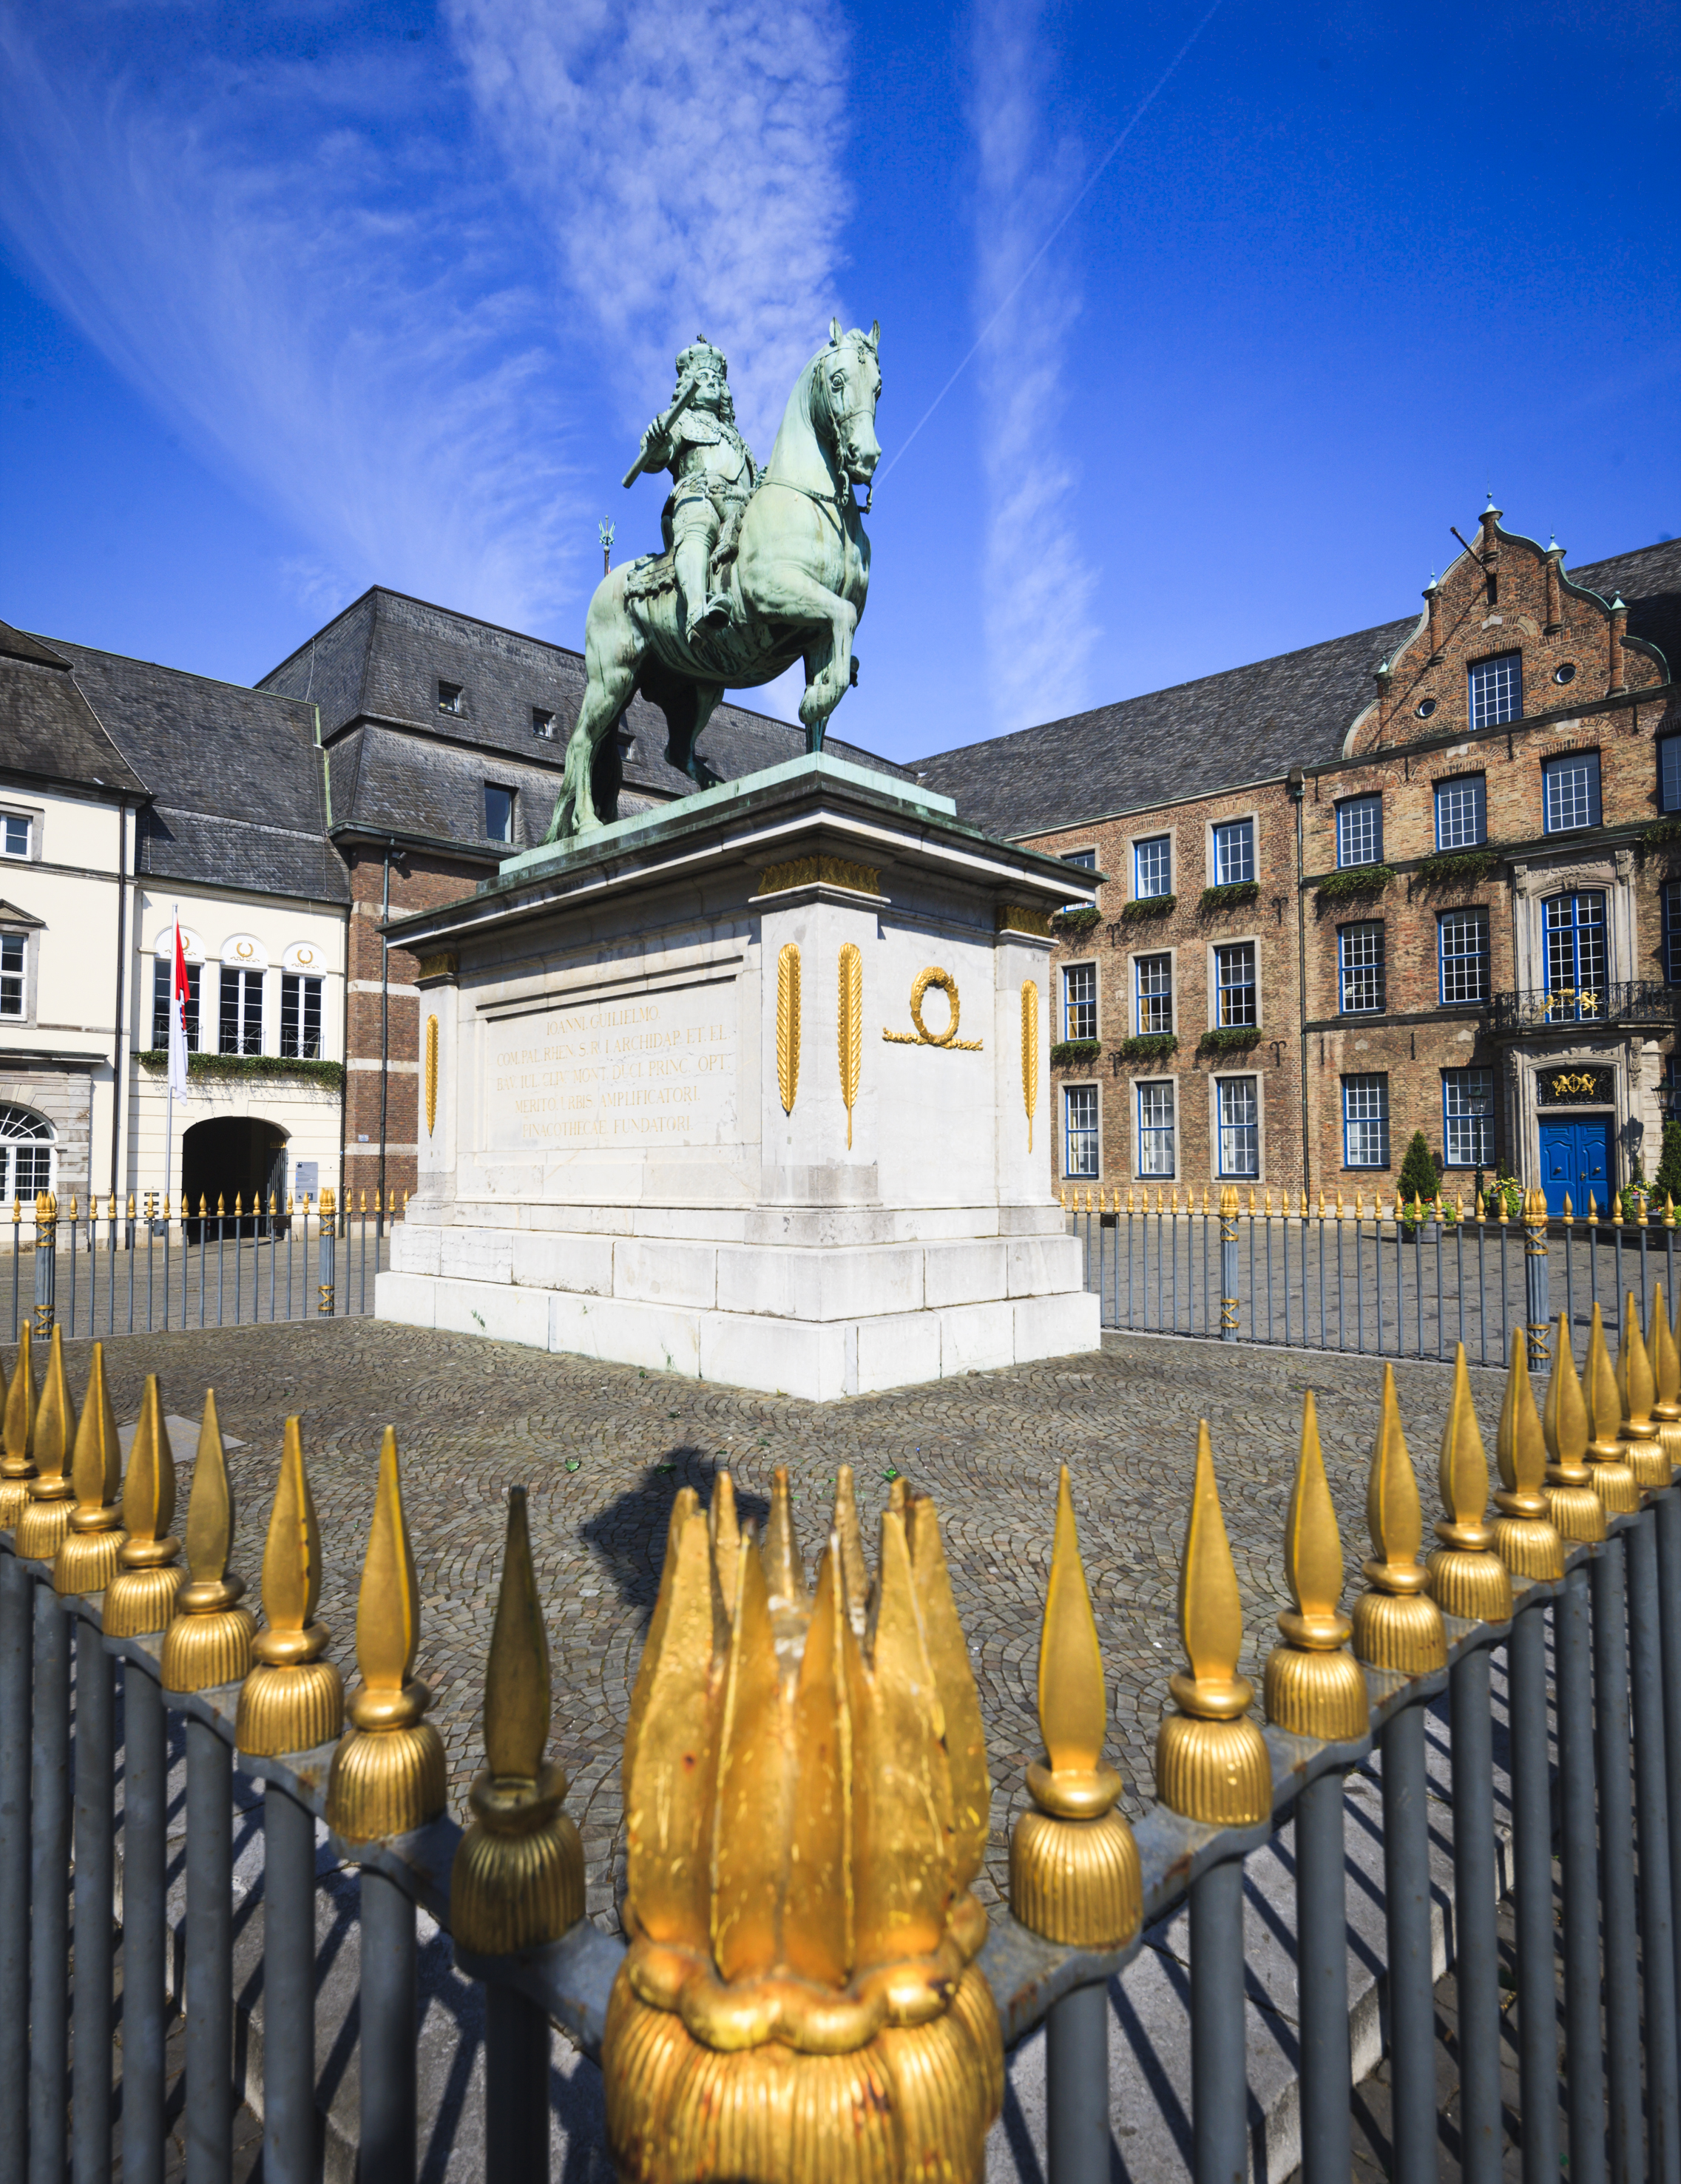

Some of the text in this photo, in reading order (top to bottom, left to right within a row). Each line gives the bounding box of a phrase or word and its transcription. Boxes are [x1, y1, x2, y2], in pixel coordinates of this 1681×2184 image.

[546, 1006, 661, 1036] IOANNI. GUILIELMO.
[497, 1052, 519, 1066] COM.
[521, 1049, 543, 1064] PAL.
[544, 1044, 575, 1061] RHEN.
[578, 1042, 589, 1057] S.
[686, 1027, 706, 1044] ET.
[710, 1024, 731, 1041] EL.
[521, 1074, 540, 1089] IUL.
[649, 1058, 691, 1077] PRINC.
[698, 1054, 731, 1072] OPT.
[515, 1097, 558, 1113] MERITO.
[601, 1086, 700, 1108] AMPLIFICATORI.
[522, 1115, 694, 1138] PINACOTHECAE. FUNDATORI.
